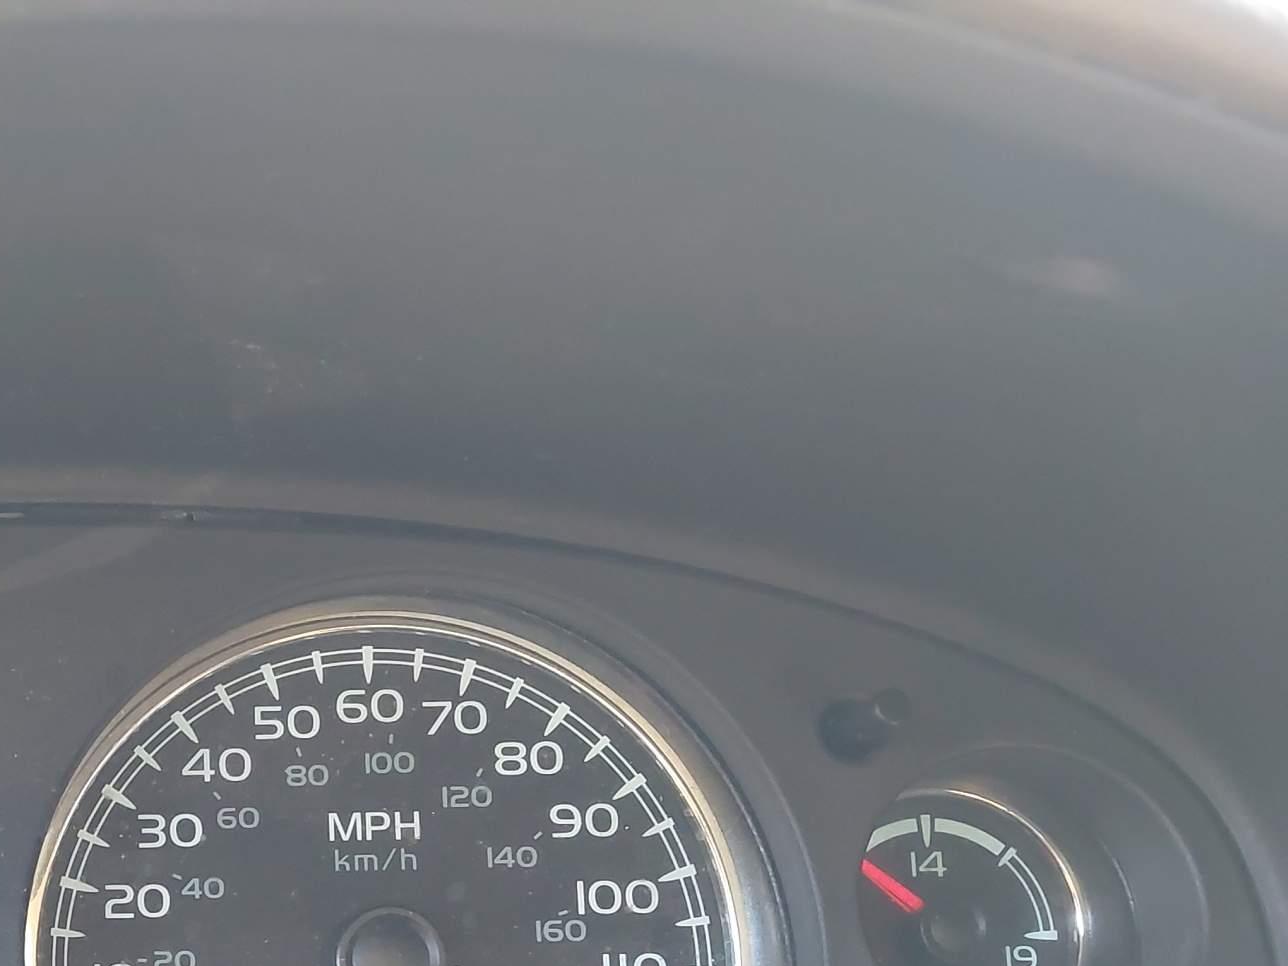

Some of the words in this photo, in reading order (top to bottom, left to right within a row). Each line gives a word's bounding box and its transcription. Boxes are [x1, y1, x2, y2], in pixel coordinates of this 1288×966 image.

[337, 689, 404, 723] 60
[422, 701, 487, 735] 70
[254, 705, 321, 739] 50
[181, 748, 251, 781] 40
[364, 752, 415, 774] 100
[495, 741, 563, 775] 80
[285, 765, 328, 787] 80
[442, 786, 493, 808] 120
[138, 814, 202, 848] 30
[216, 808, 260, 829] 60
[328, 810, 421, 841] MPH
[550, 803, 619, 838] 90
[334, 847, 417, 872] km/h
[486, 846, 538, 868] 140
[910, 851, 948, 877] 14
[105, 884, 170, 919] 20
[181, 877, 225, 899] 40
[576, 879, 659, 914] 100
[535, 919, 587, 942] 160
